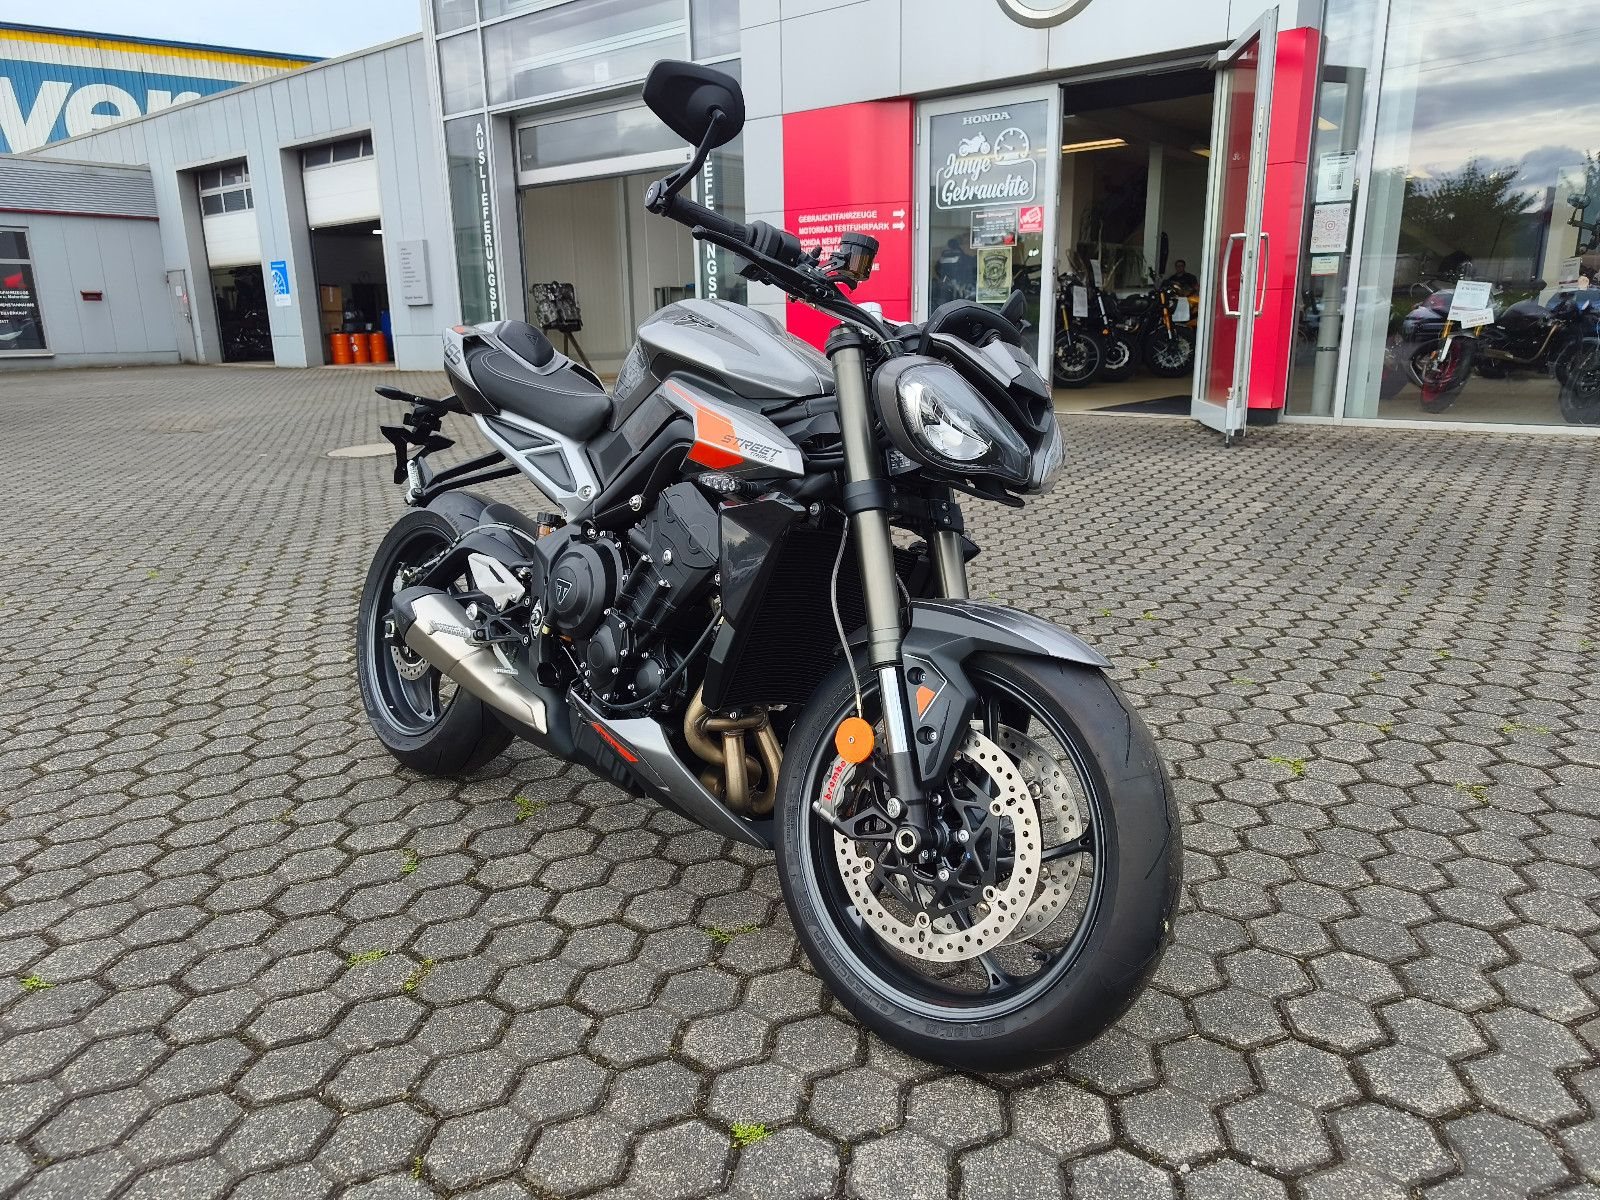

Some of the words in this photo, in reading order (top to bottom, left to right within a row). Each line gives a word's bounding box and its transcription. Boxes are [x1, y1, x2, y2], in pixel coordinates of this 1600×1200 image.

[962, 111, 1011, 125] HONDA
[943, 153, 992, 181] Junge
[941, 173, 1030, 205] Gebrauchte
[798, 210, 878, 223] GEBRAUCHTFAHRZEUGE
[798, 225, 834, 235] MOTORRAD
[720, 434, 783, 458] STREET
[824, 760, 847, 801] brembo
